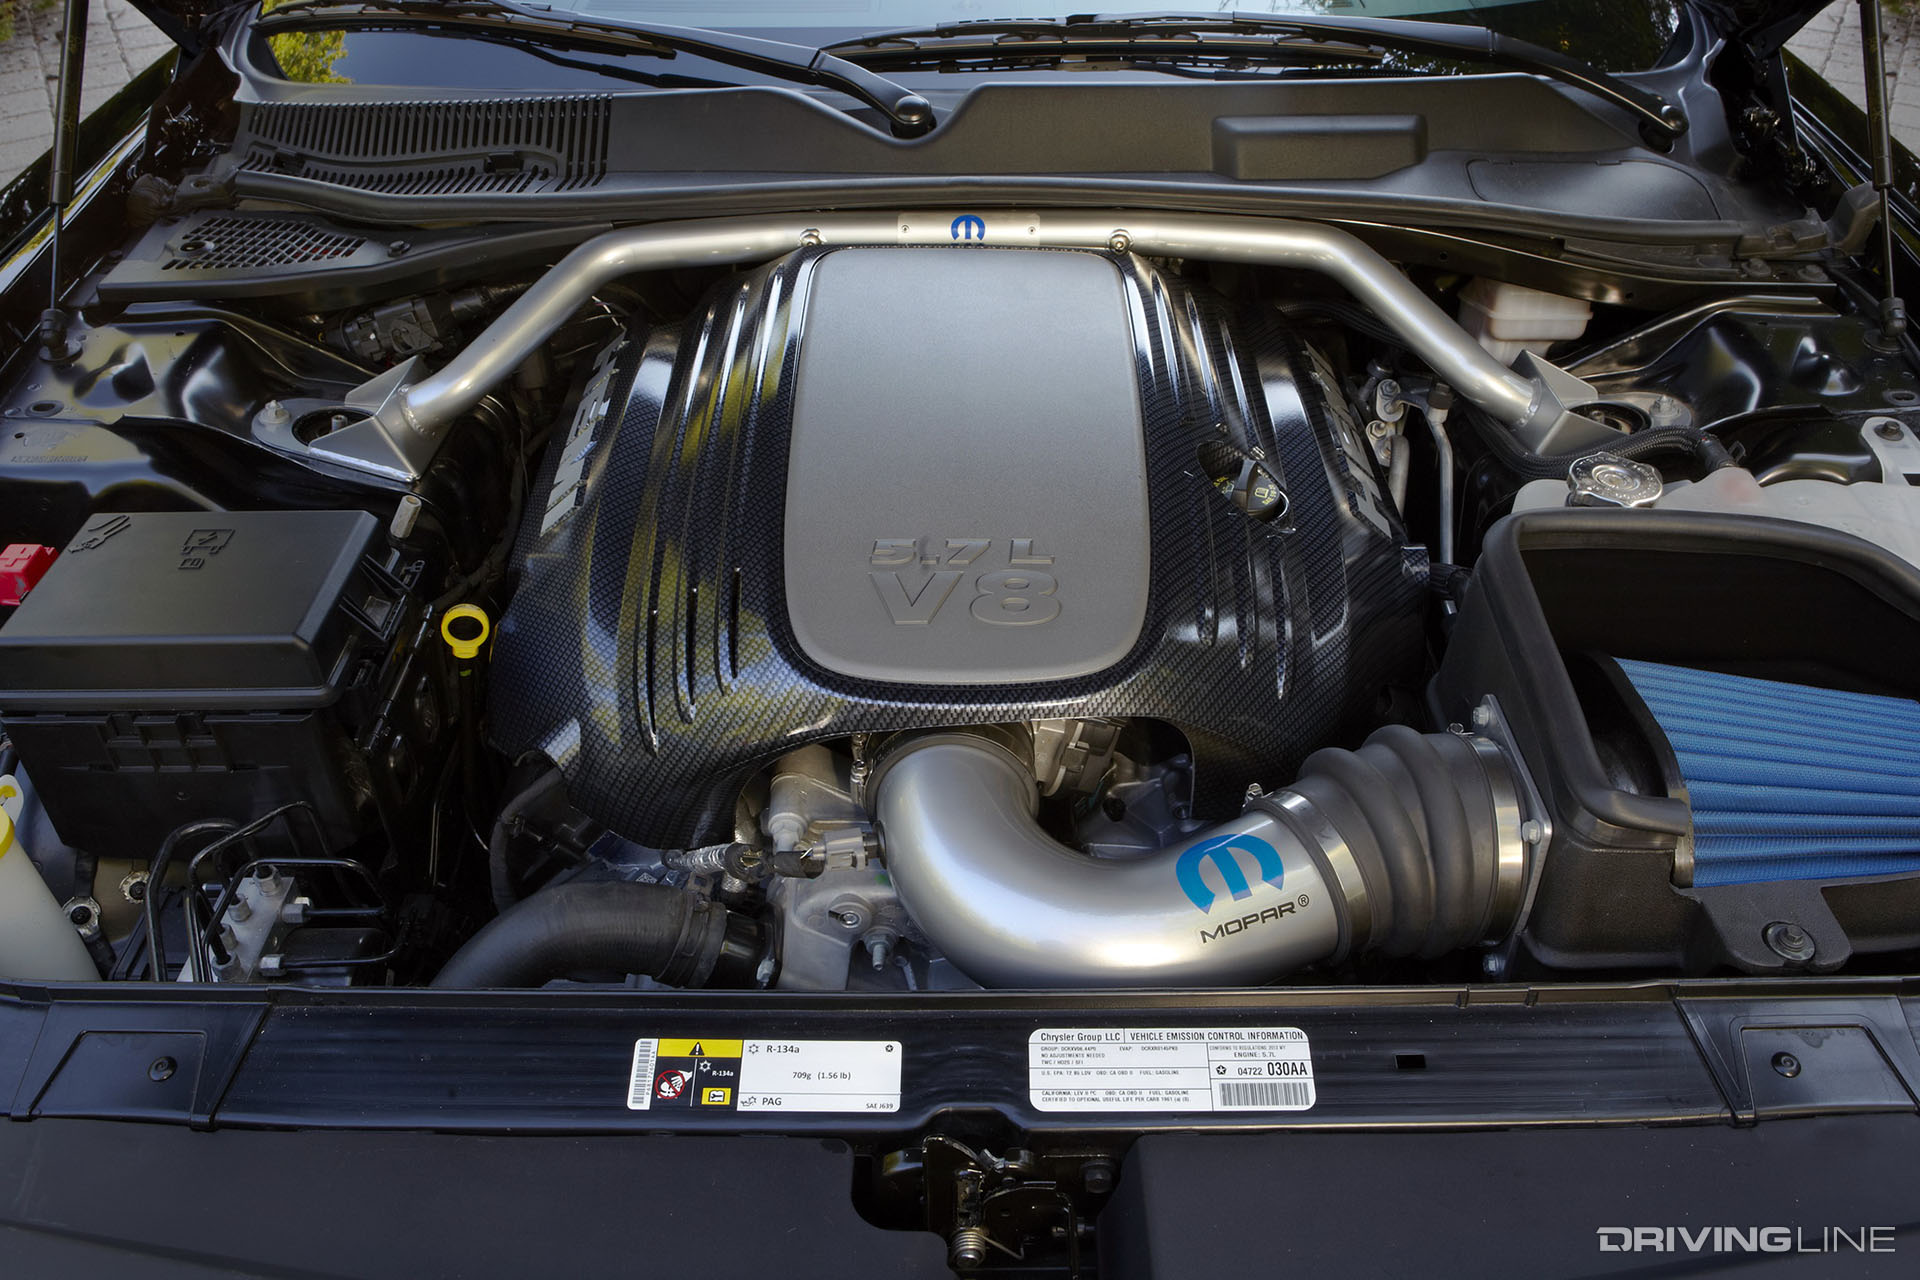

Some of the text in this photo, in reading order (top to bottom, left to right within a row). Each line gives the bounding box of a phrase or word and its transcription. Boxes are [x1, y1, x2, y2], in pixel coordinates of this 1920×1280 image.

[867, 568, 1062, 625] V8
[1040, 1032, 1121, 1042] Chrysler Group LLC
[1130, 1032, 1303, 1041] VEHICLE EMISSION CONTROL INFORMATION
[766, 1045, 800, 1053] R-134a
[1237, 1062, 1308, 1076] 04722 030AA
[792, 1072, 851, 1080] 709g (1.56 lb)
[762, 1097, 782, 1106] PAG
